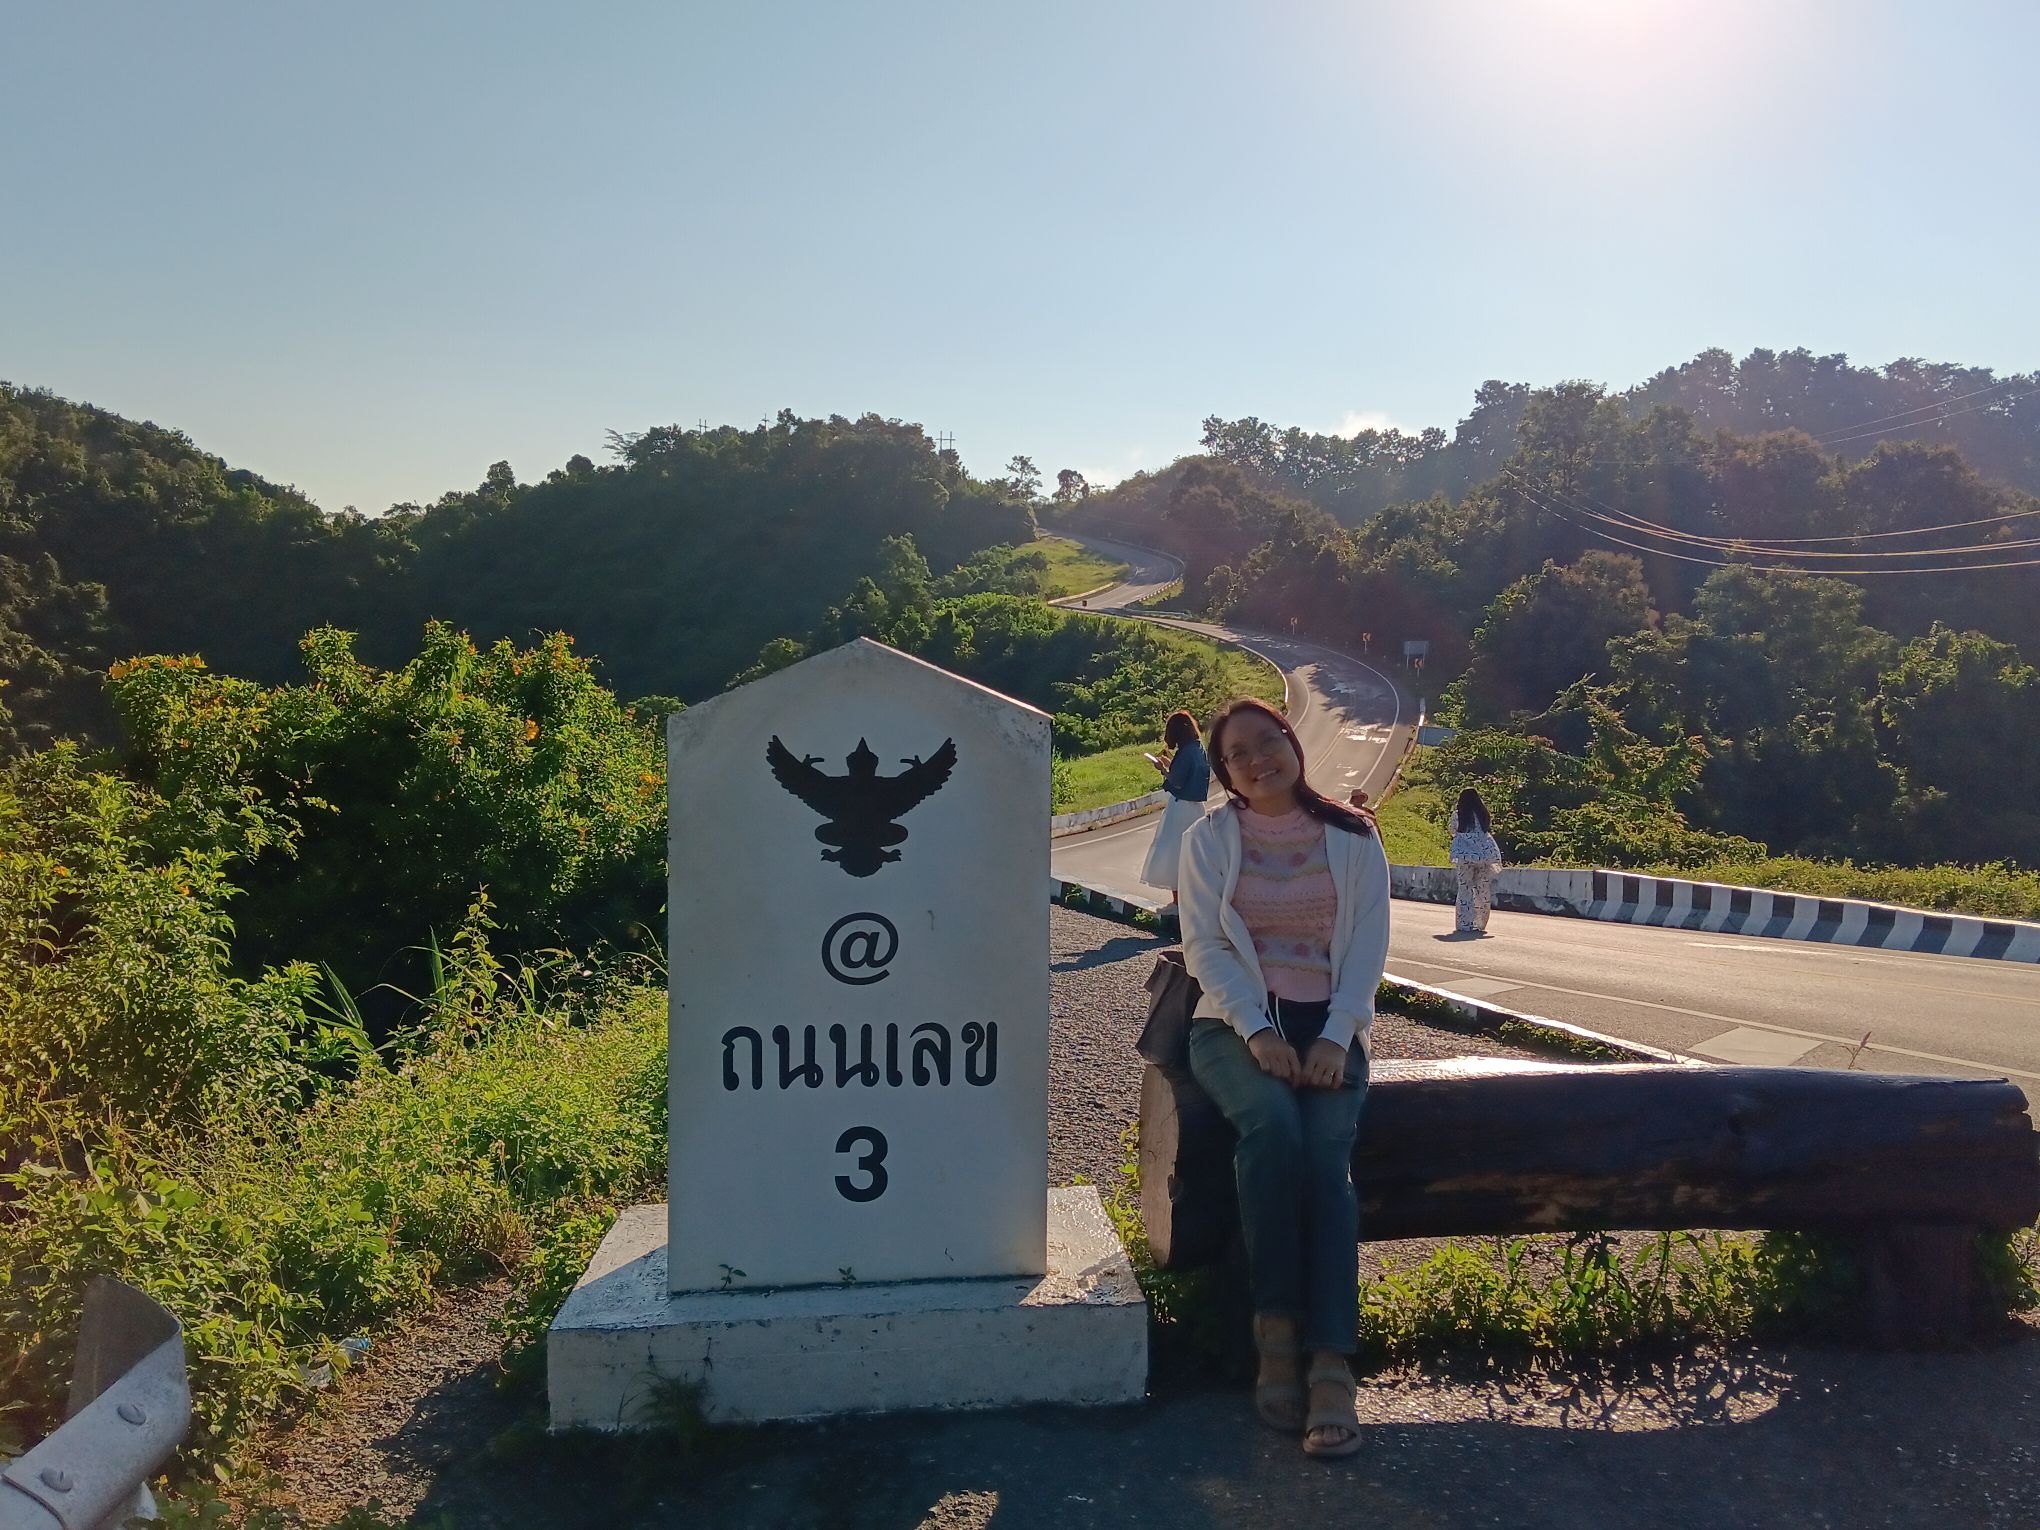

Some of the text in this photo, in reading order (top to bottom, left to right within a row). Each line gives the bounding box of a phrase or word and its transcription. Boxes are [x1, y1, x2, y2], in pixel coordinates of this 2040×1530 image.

[821, 911, 899, 986] @
[720, 1021, 998, 1091] ถนนเลข
[834, 1125, 889, 1203] 3
